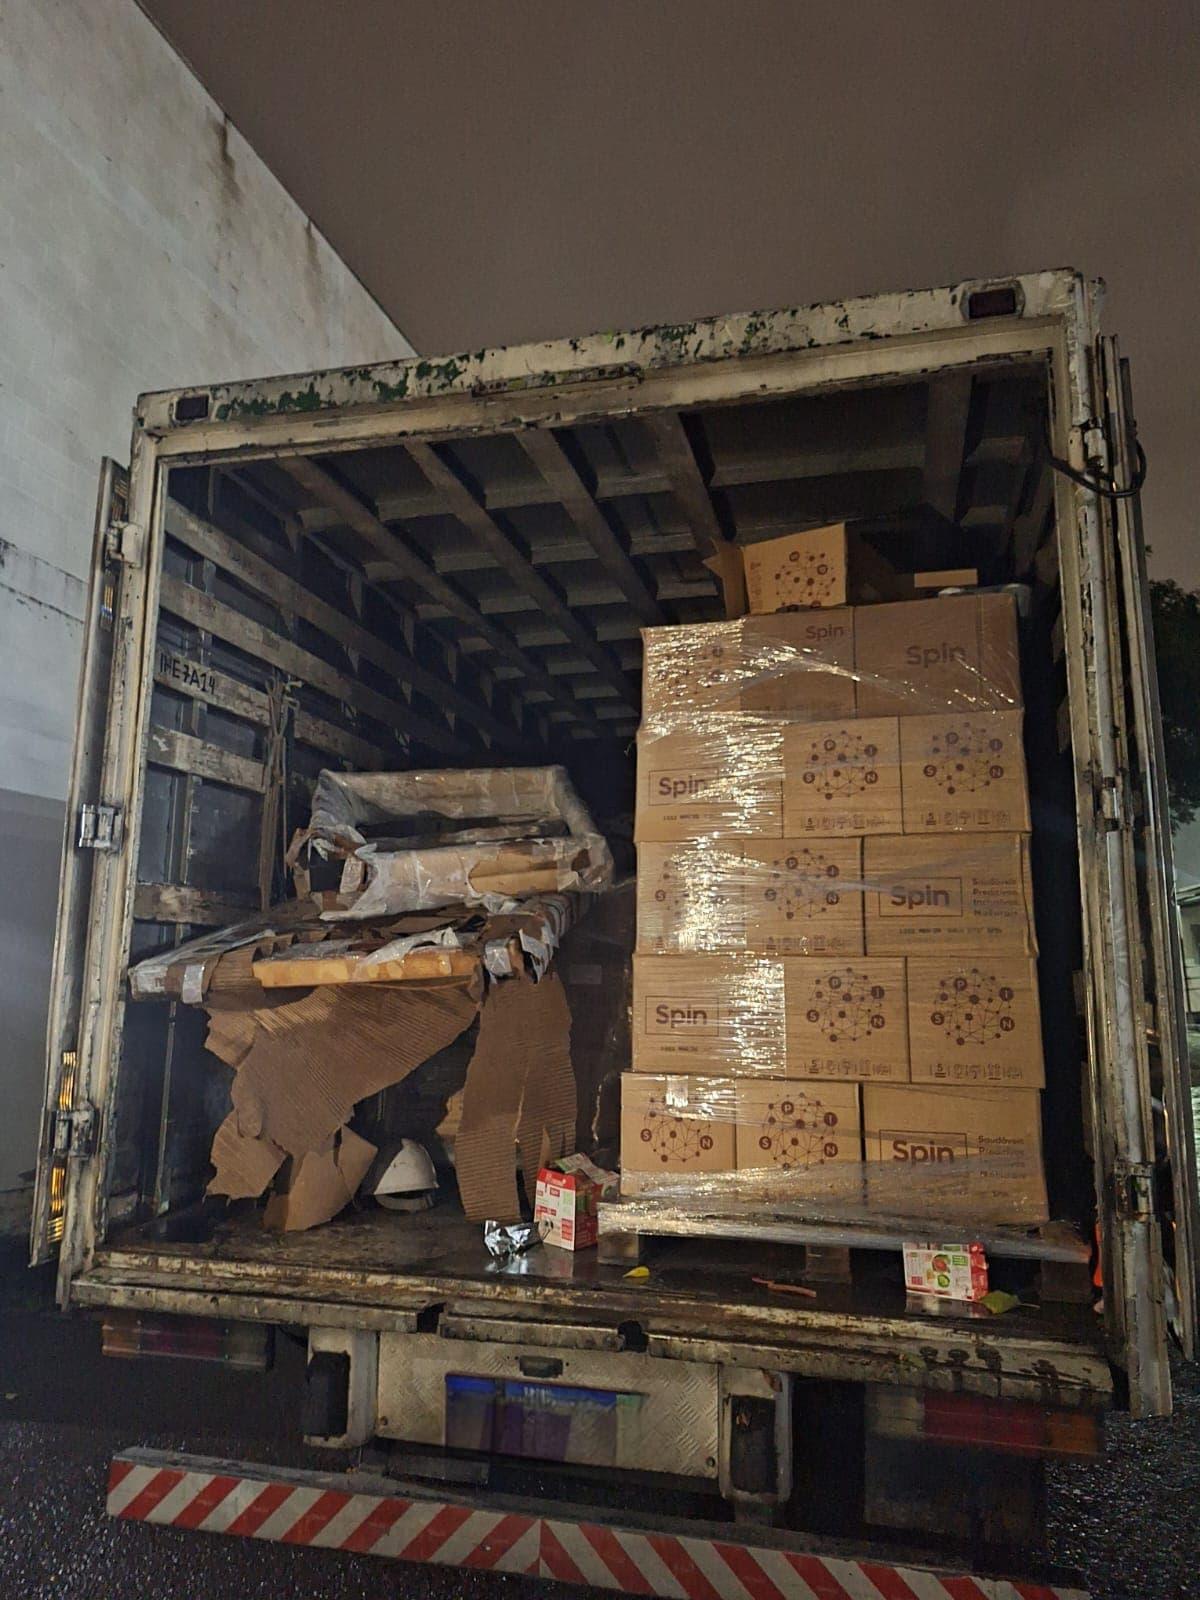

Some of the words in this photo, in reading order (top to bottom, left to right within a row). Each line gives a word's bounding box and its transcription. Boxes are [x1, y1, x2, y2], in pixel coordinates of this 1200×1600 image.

[806, 624, 844, 642] Spin
[905, 642, 967, 668] Spin
[890, 884, 950, 910] Spin
[655, 1003, 708, 1029] Spin
[893, 1139, 954, 1167] Spin
